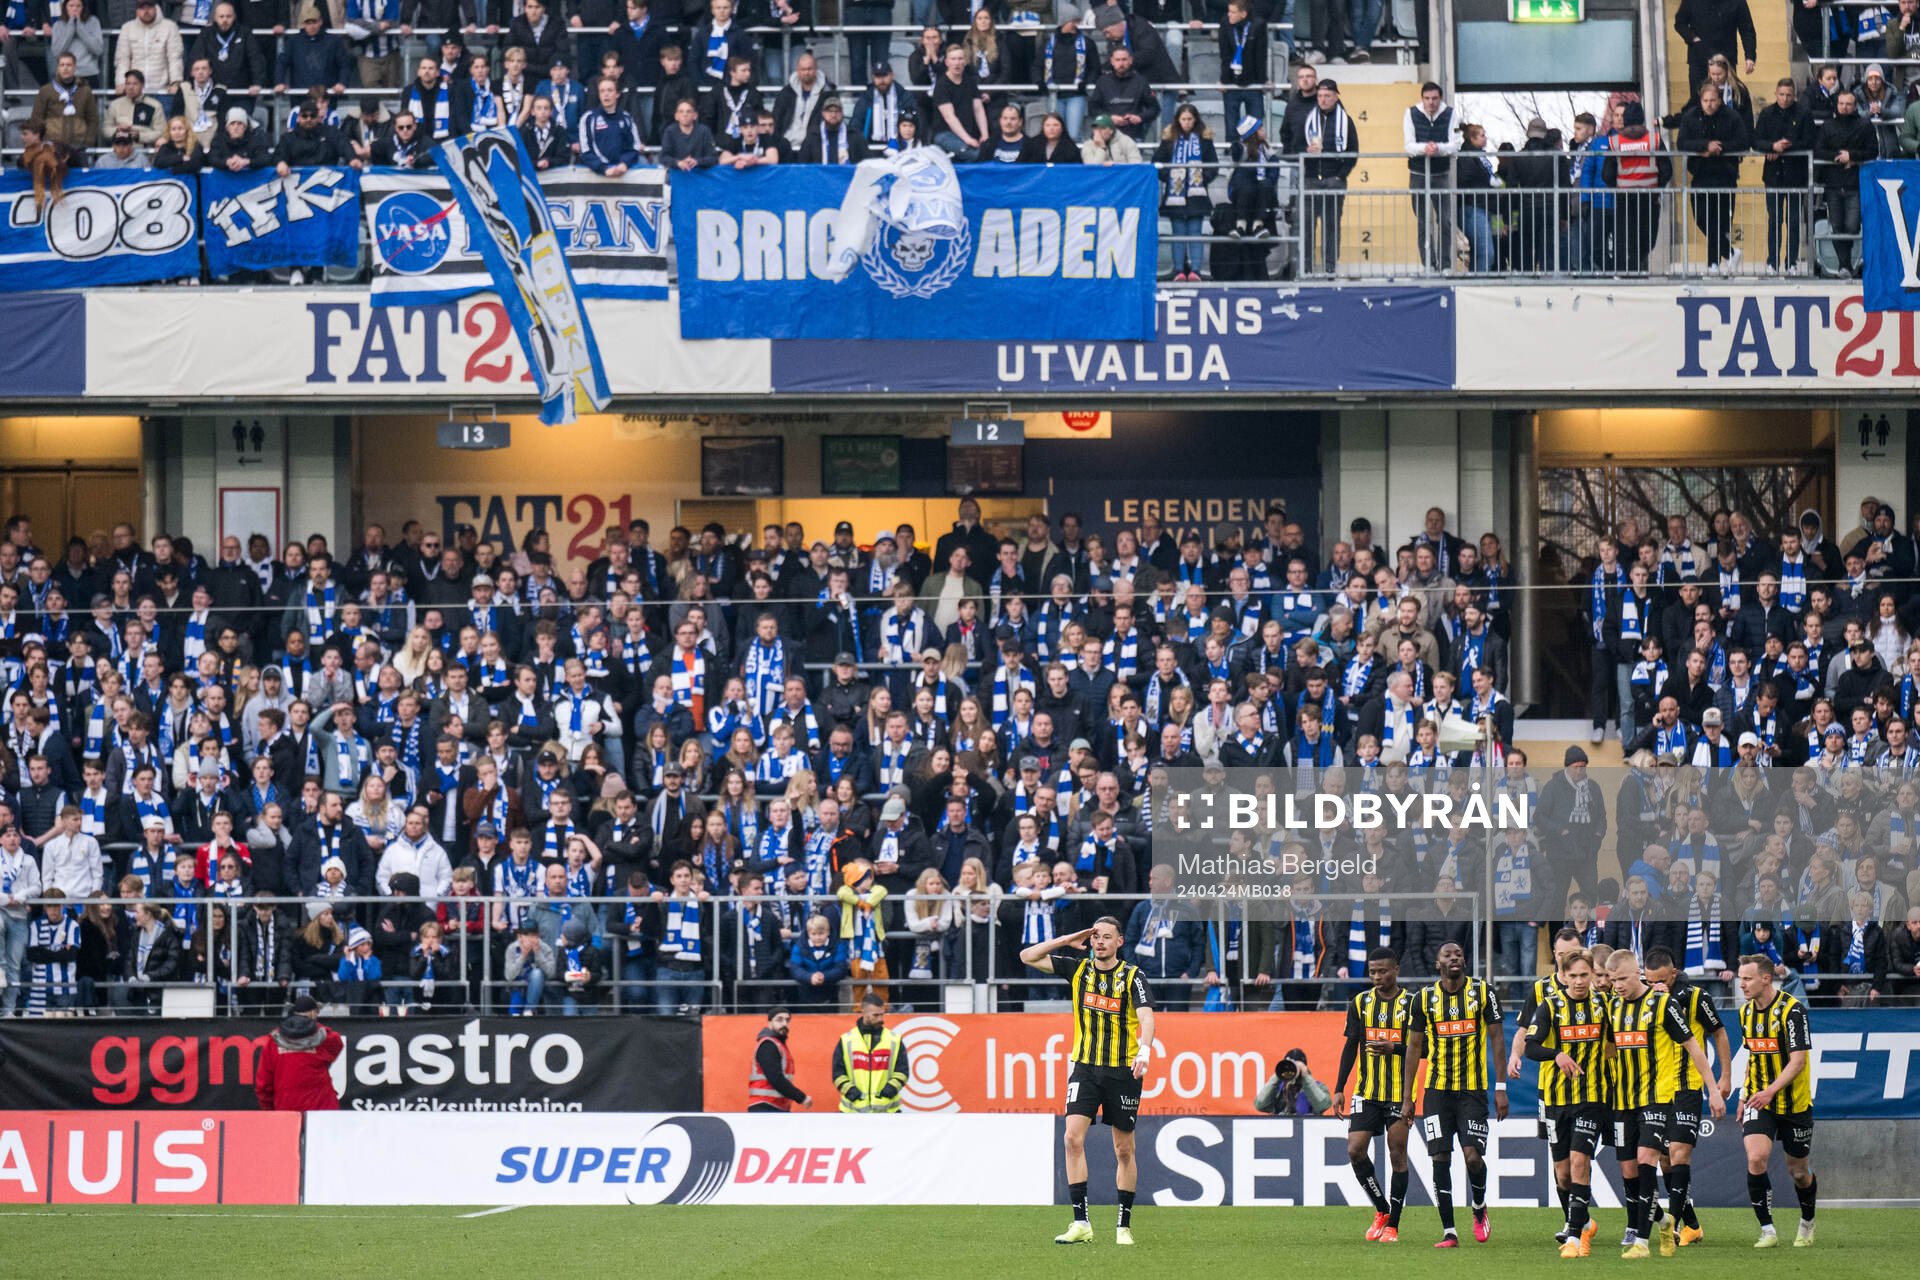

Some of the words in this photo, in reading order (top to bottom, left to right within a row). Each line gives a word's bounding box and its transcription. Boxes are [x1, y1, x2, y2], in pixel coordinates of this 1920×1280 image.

[207, 167, 355, 247] IFK
[378, 223, 448, 242] VASA
[973, 206, 1141, 279] ADEN
[1362, 232, 1371, 243] 2
[1154, 298, 1262, 335] ENS
[307, 302, 534, 383] FAT2
[998, 344, 1230, 382] UTVALDA
[462, 425, 485, 443] 13
[976, 423, 999, 441] 12
[1105, 499, 1286, 523] LEGENDENS
[435, 494, 633, 562] FAT21
[1085, 994, 1119, 1009] BRA
[1438, 1022, 1475, 1033] BRA
[1667, 1005, 1691, 1035] stadium
[1642, 1111, 1668, 1123] Varis
[1675, 1111, 1699, 1123] Varis
[495, 1146, 671, 1184] SUPER
[734, 1147, 873, 1183] DAEK
